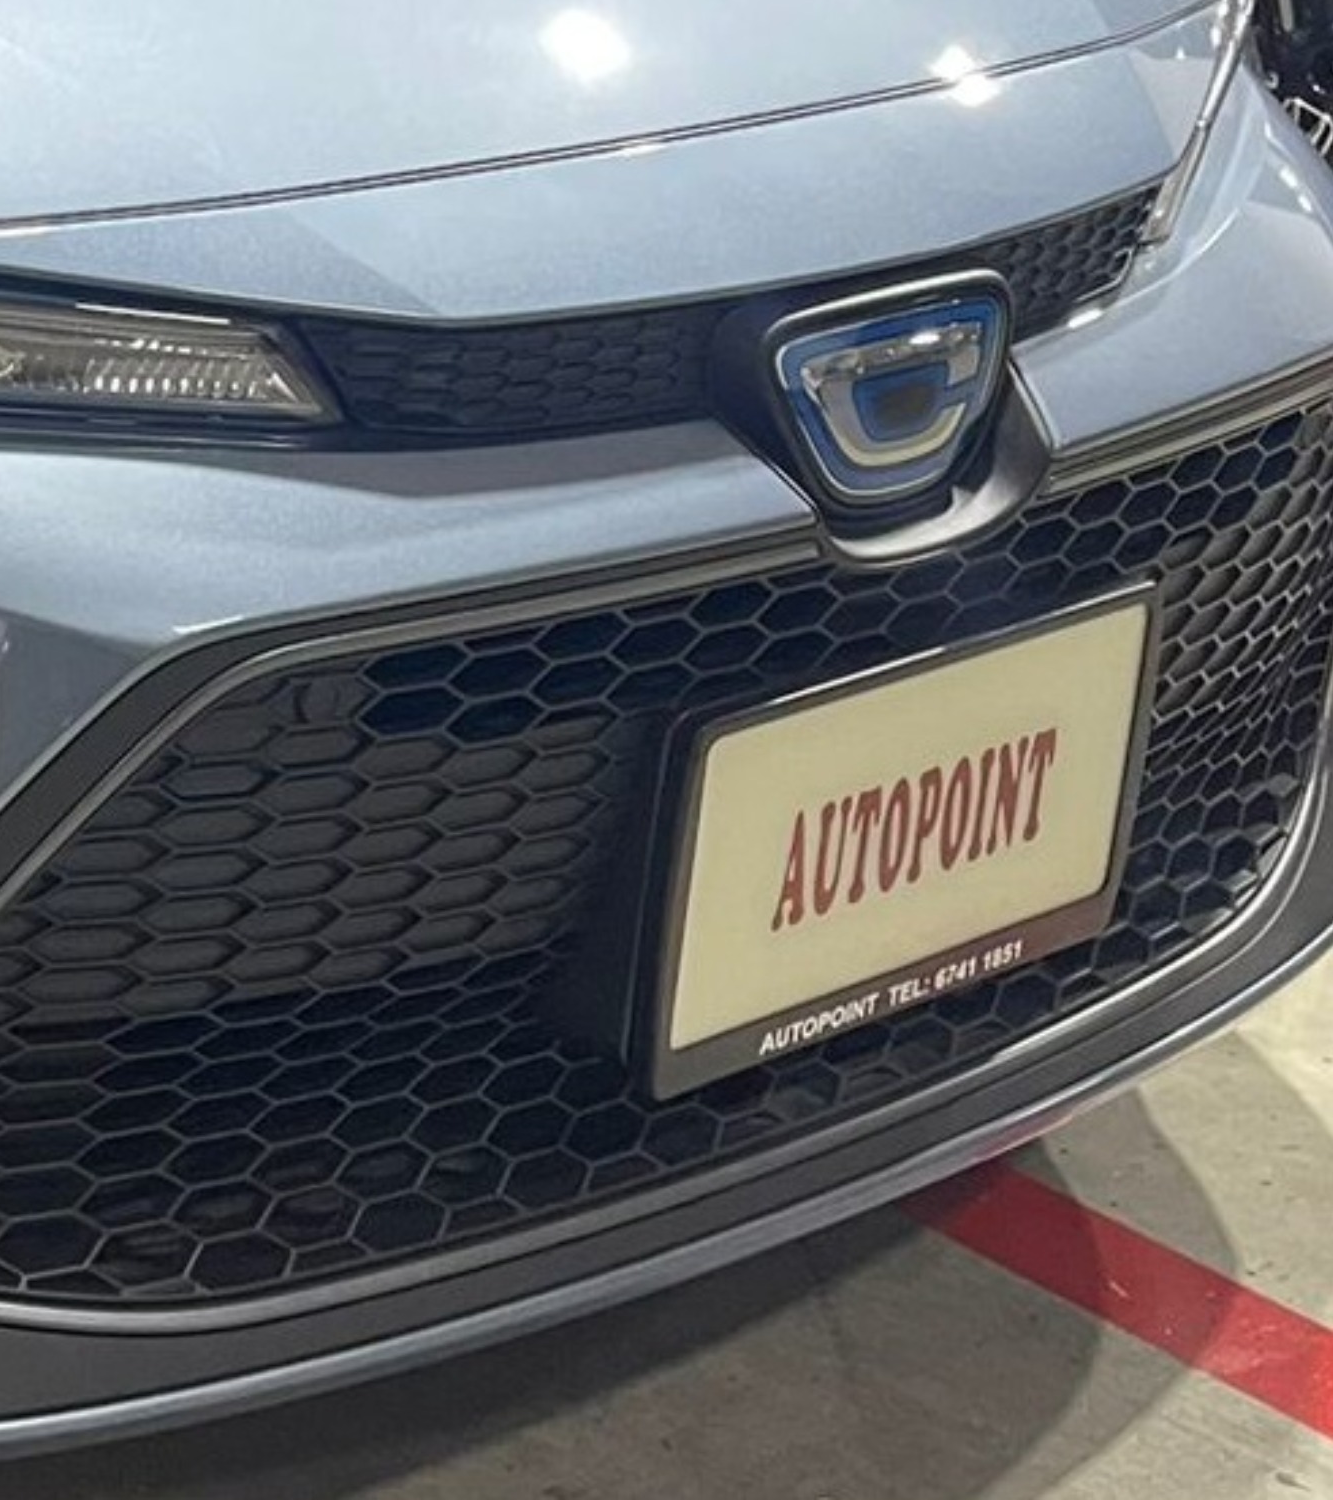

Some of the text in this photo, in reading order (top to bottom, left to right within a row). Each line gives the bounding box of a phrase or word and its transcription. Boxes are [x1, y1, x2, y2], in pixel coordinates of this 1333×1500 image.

[771, 728, 1057, 932] AUTOPOINT
[758, 991, 880, 1056] AUTOPOINT
[887, 977, 933, 1007] TEL:
[935, 956, 977, 990] 6741
